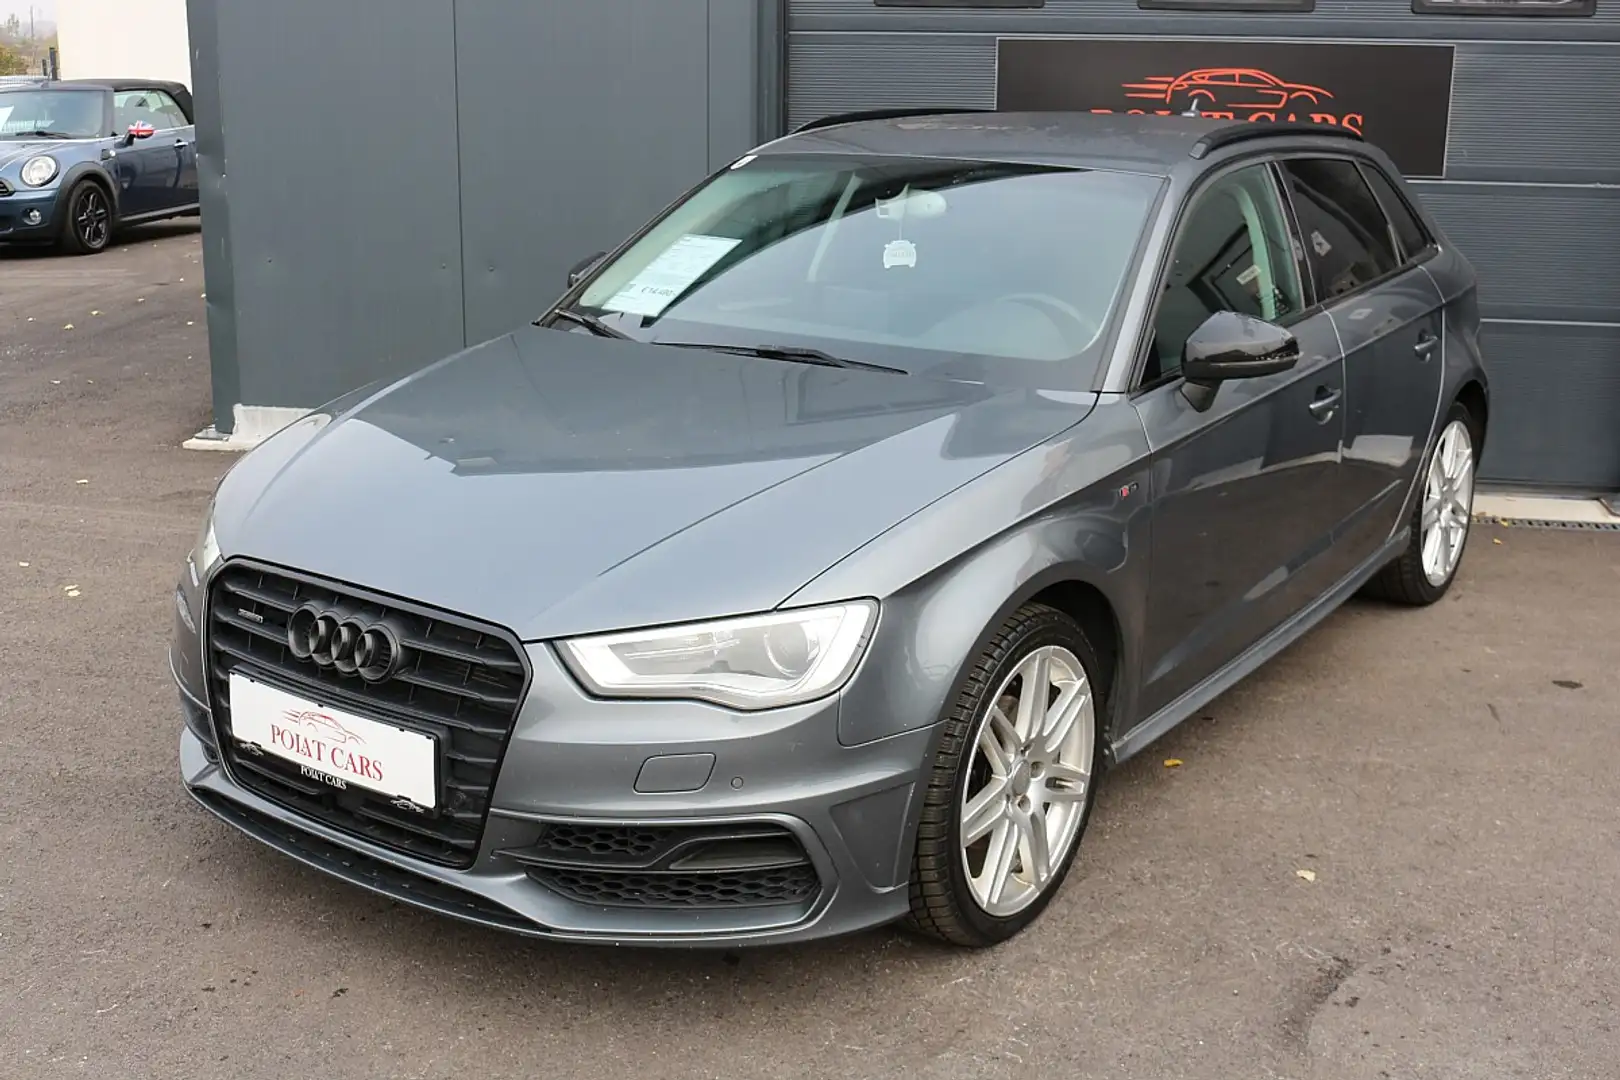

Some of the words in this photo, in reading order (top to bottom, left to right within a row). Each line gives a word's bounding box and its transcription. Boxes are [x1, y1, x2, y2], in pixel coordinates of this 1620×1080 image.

[271, 723, 326, 762] POLAT
[331, 747, 384, 781] CARS
[325, 775, 347, 790] CARS
